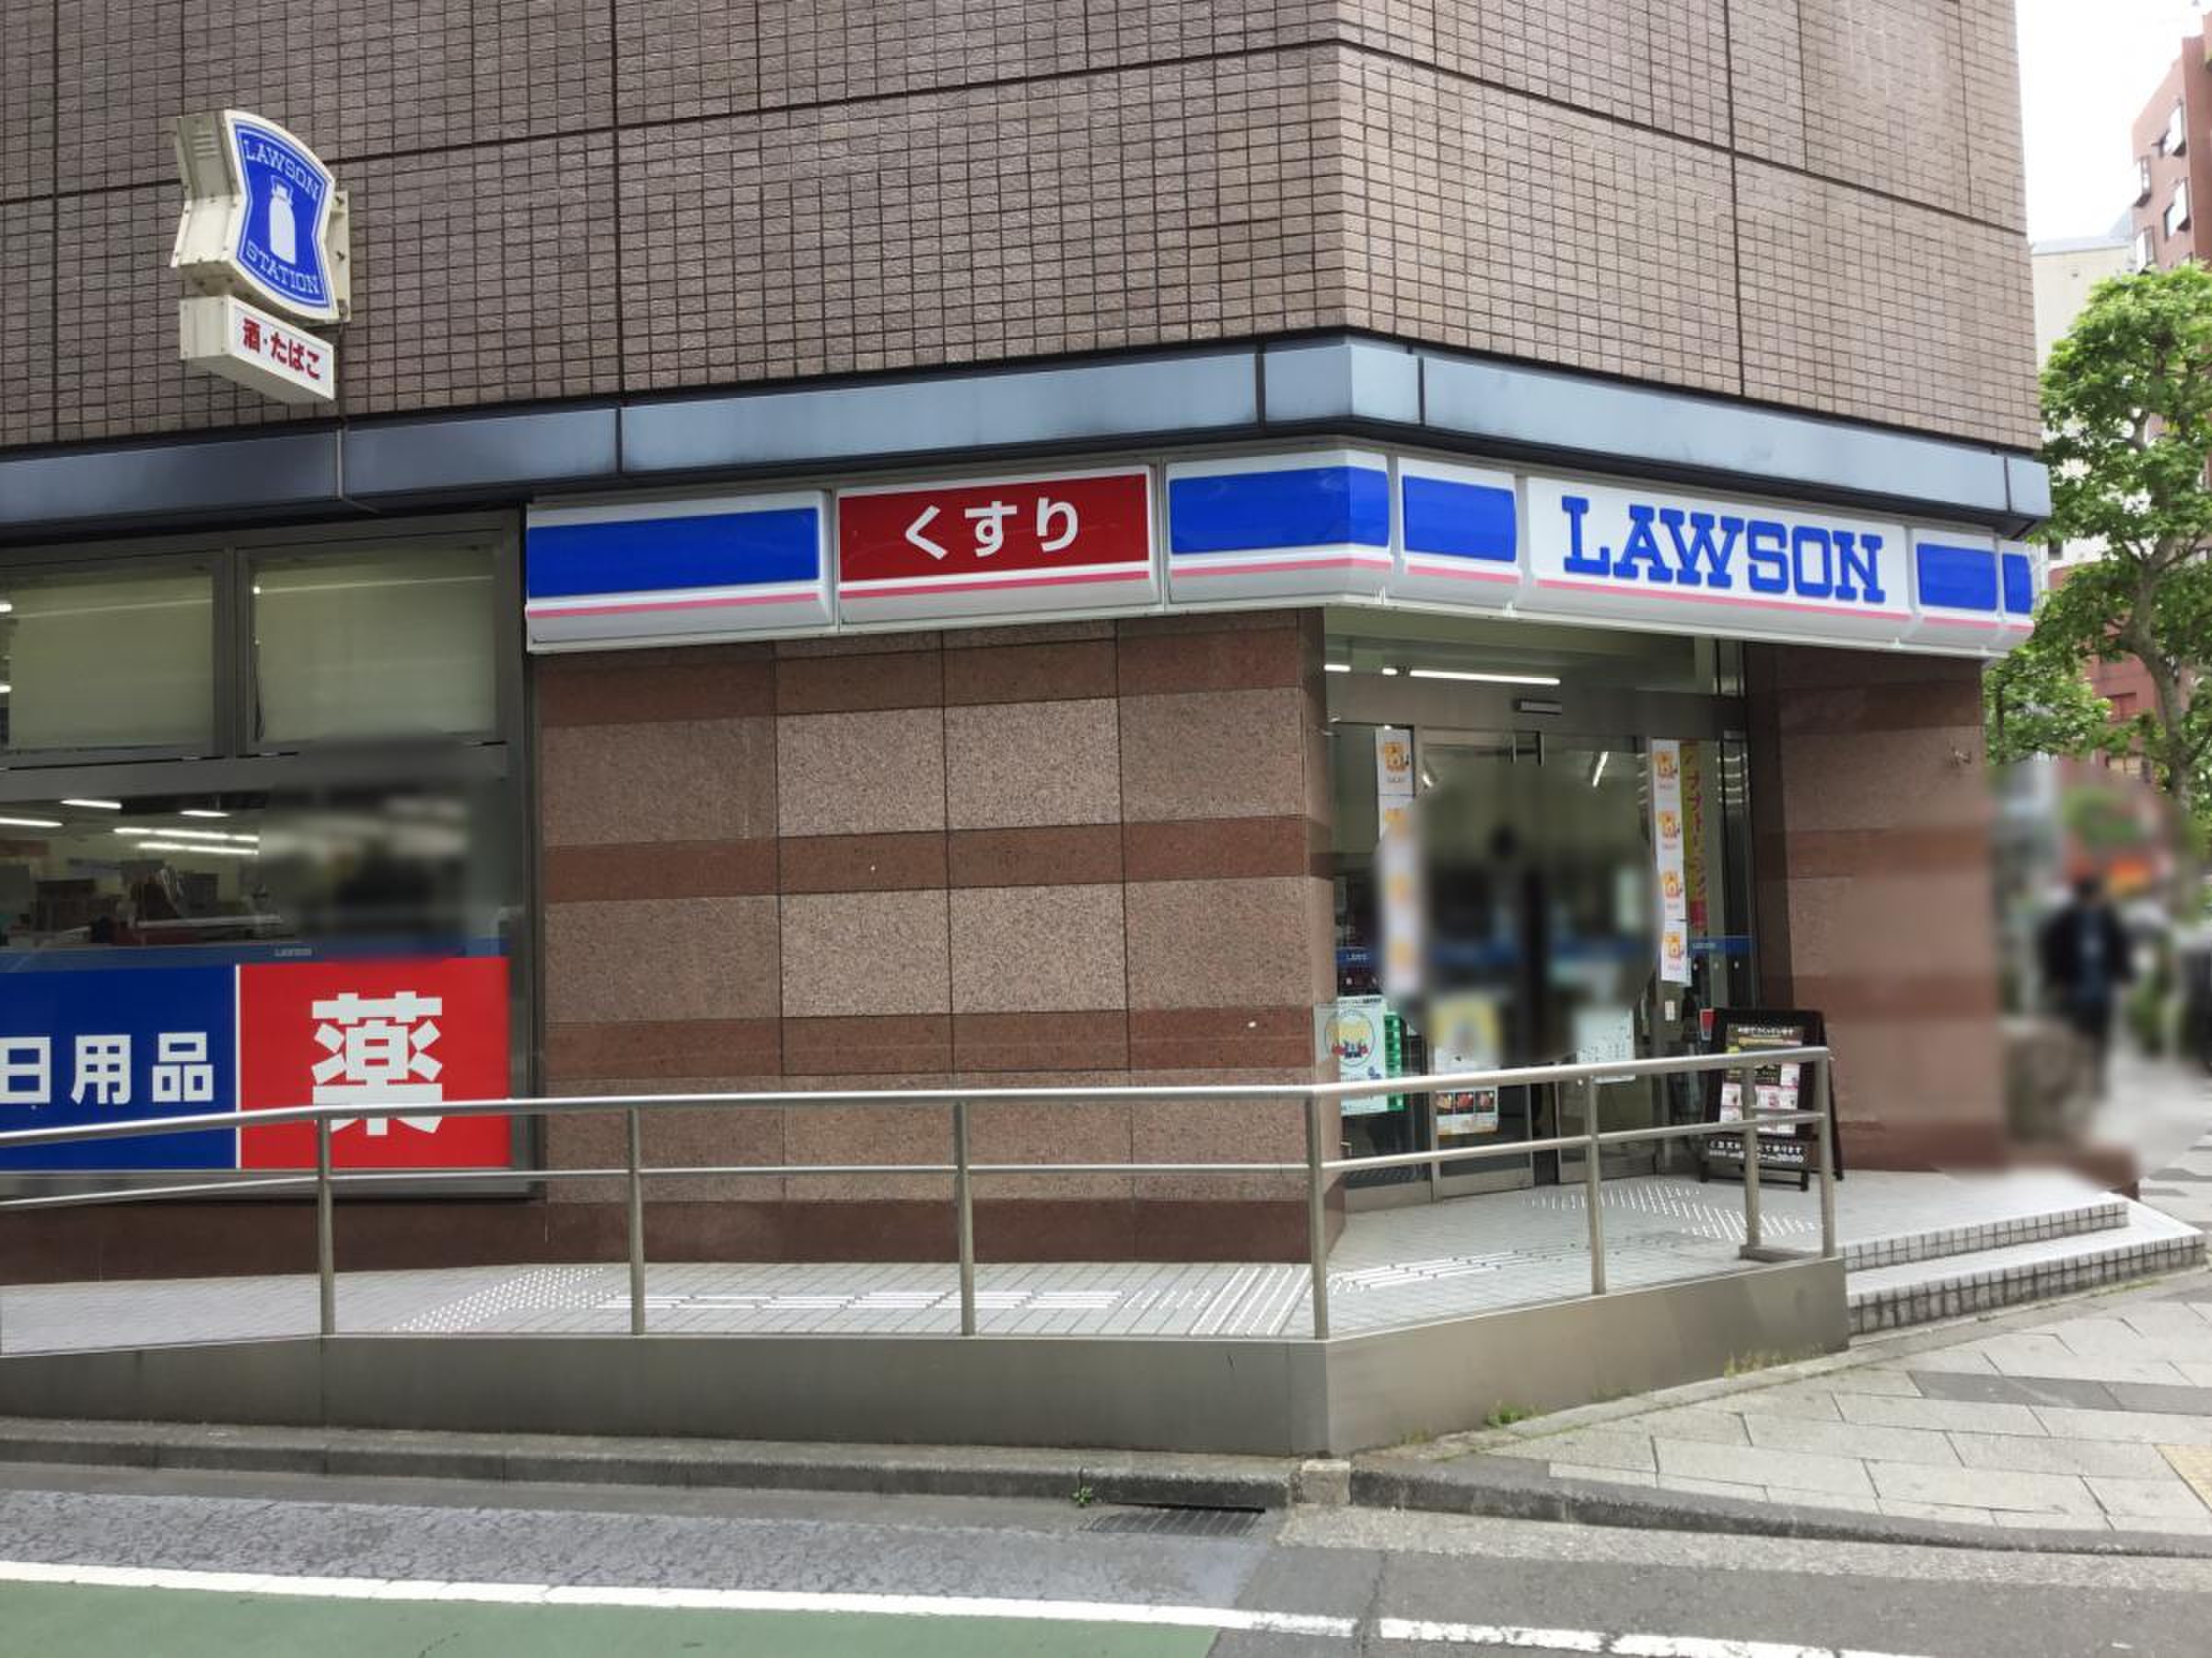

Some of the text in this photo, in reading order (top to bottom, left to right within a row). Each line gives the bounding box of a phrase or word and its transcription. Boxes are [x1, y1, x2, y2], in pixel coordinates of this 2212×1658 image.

[244, 139, 320, 201] LAWSON
[247, 240, 321, 295] STATION
[242, 317, 320, 379] 酒・たばこ
[905, 496, 1077, 560] くすり
[1562, 496, 1885, 602] LAWSON
[0, 1032, 214, 1104] 日用品
[310, 990, 442, 1136] 薬
